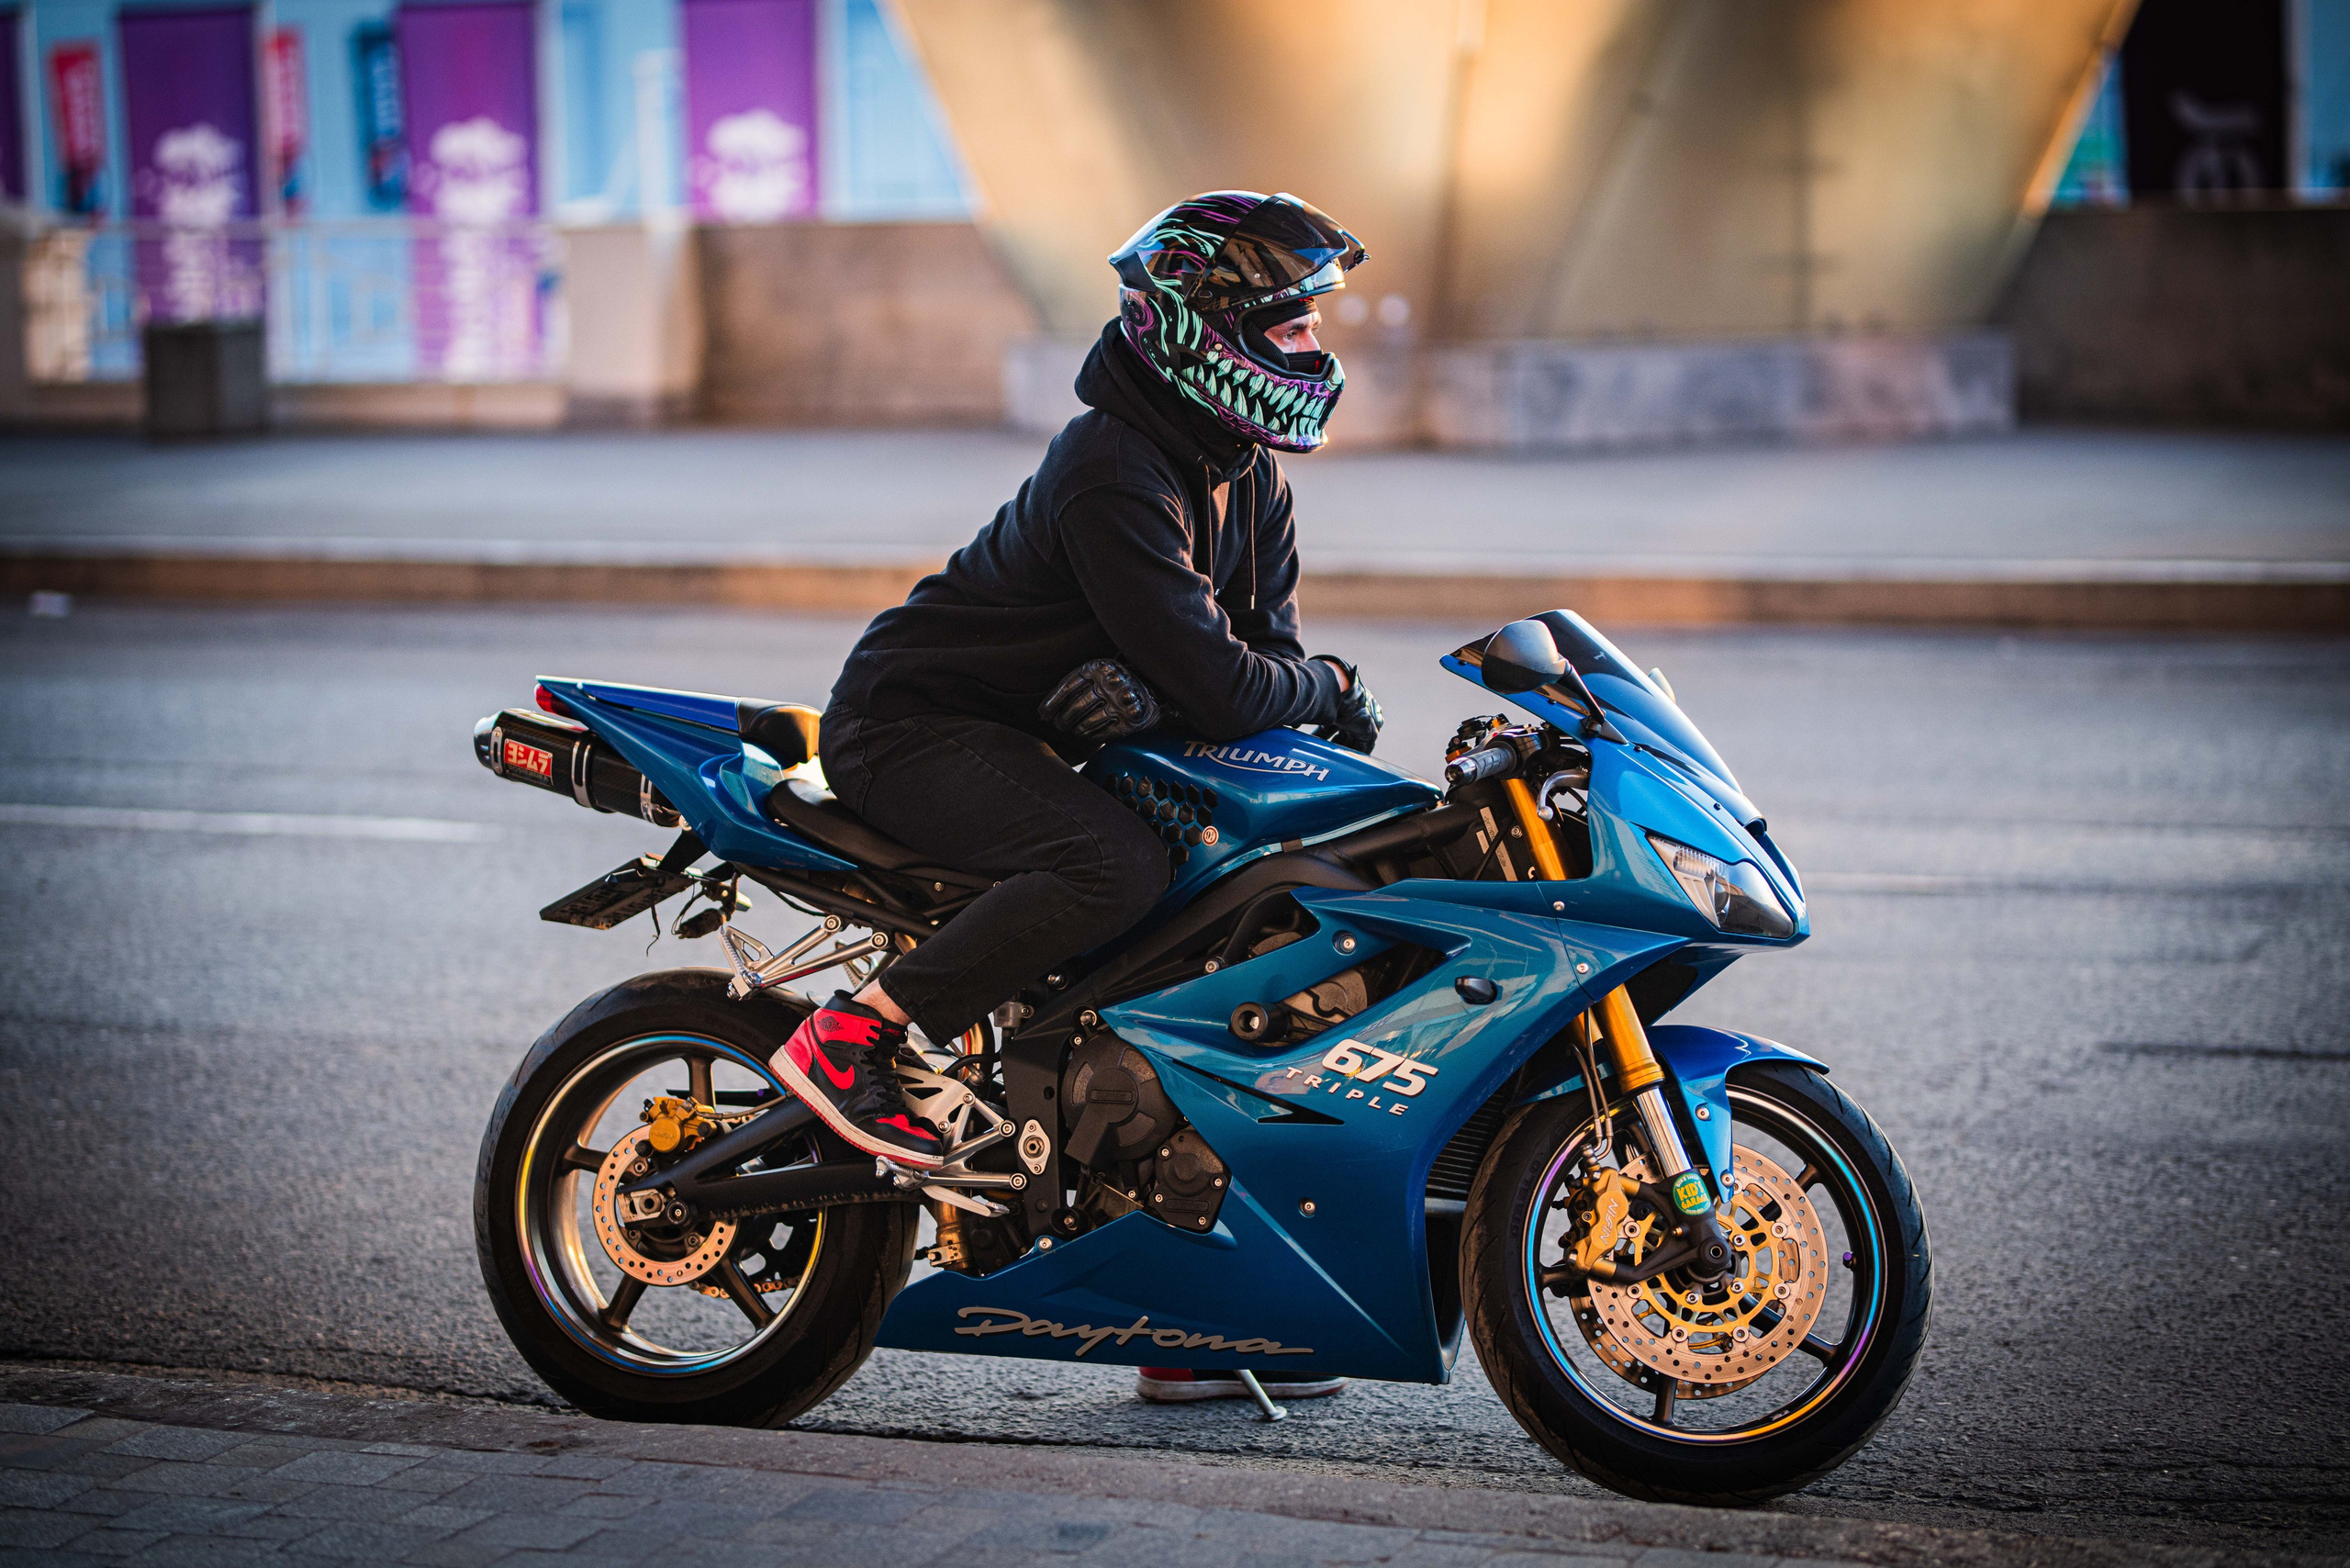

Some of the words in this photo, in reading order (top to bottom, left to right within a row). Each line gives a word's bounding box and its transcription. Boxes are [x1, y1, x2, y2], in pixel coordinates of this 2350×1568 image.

[508, 742, 549, 773] ヨシムラ
[1183, 740, 1330, 782] TRIUMPH
[1286, 1066, 1409, 1116] TRIPLE
[1322, 1038, 1439, 1098] 675
[1510, 1159, 1542, 1239] DIABLO
[1599, 1197, 1618, 1245] NISSIN
[1682, 1193, 1709, 1210] GARAGE
[954, 1306, 1315, 1357] Daytona
